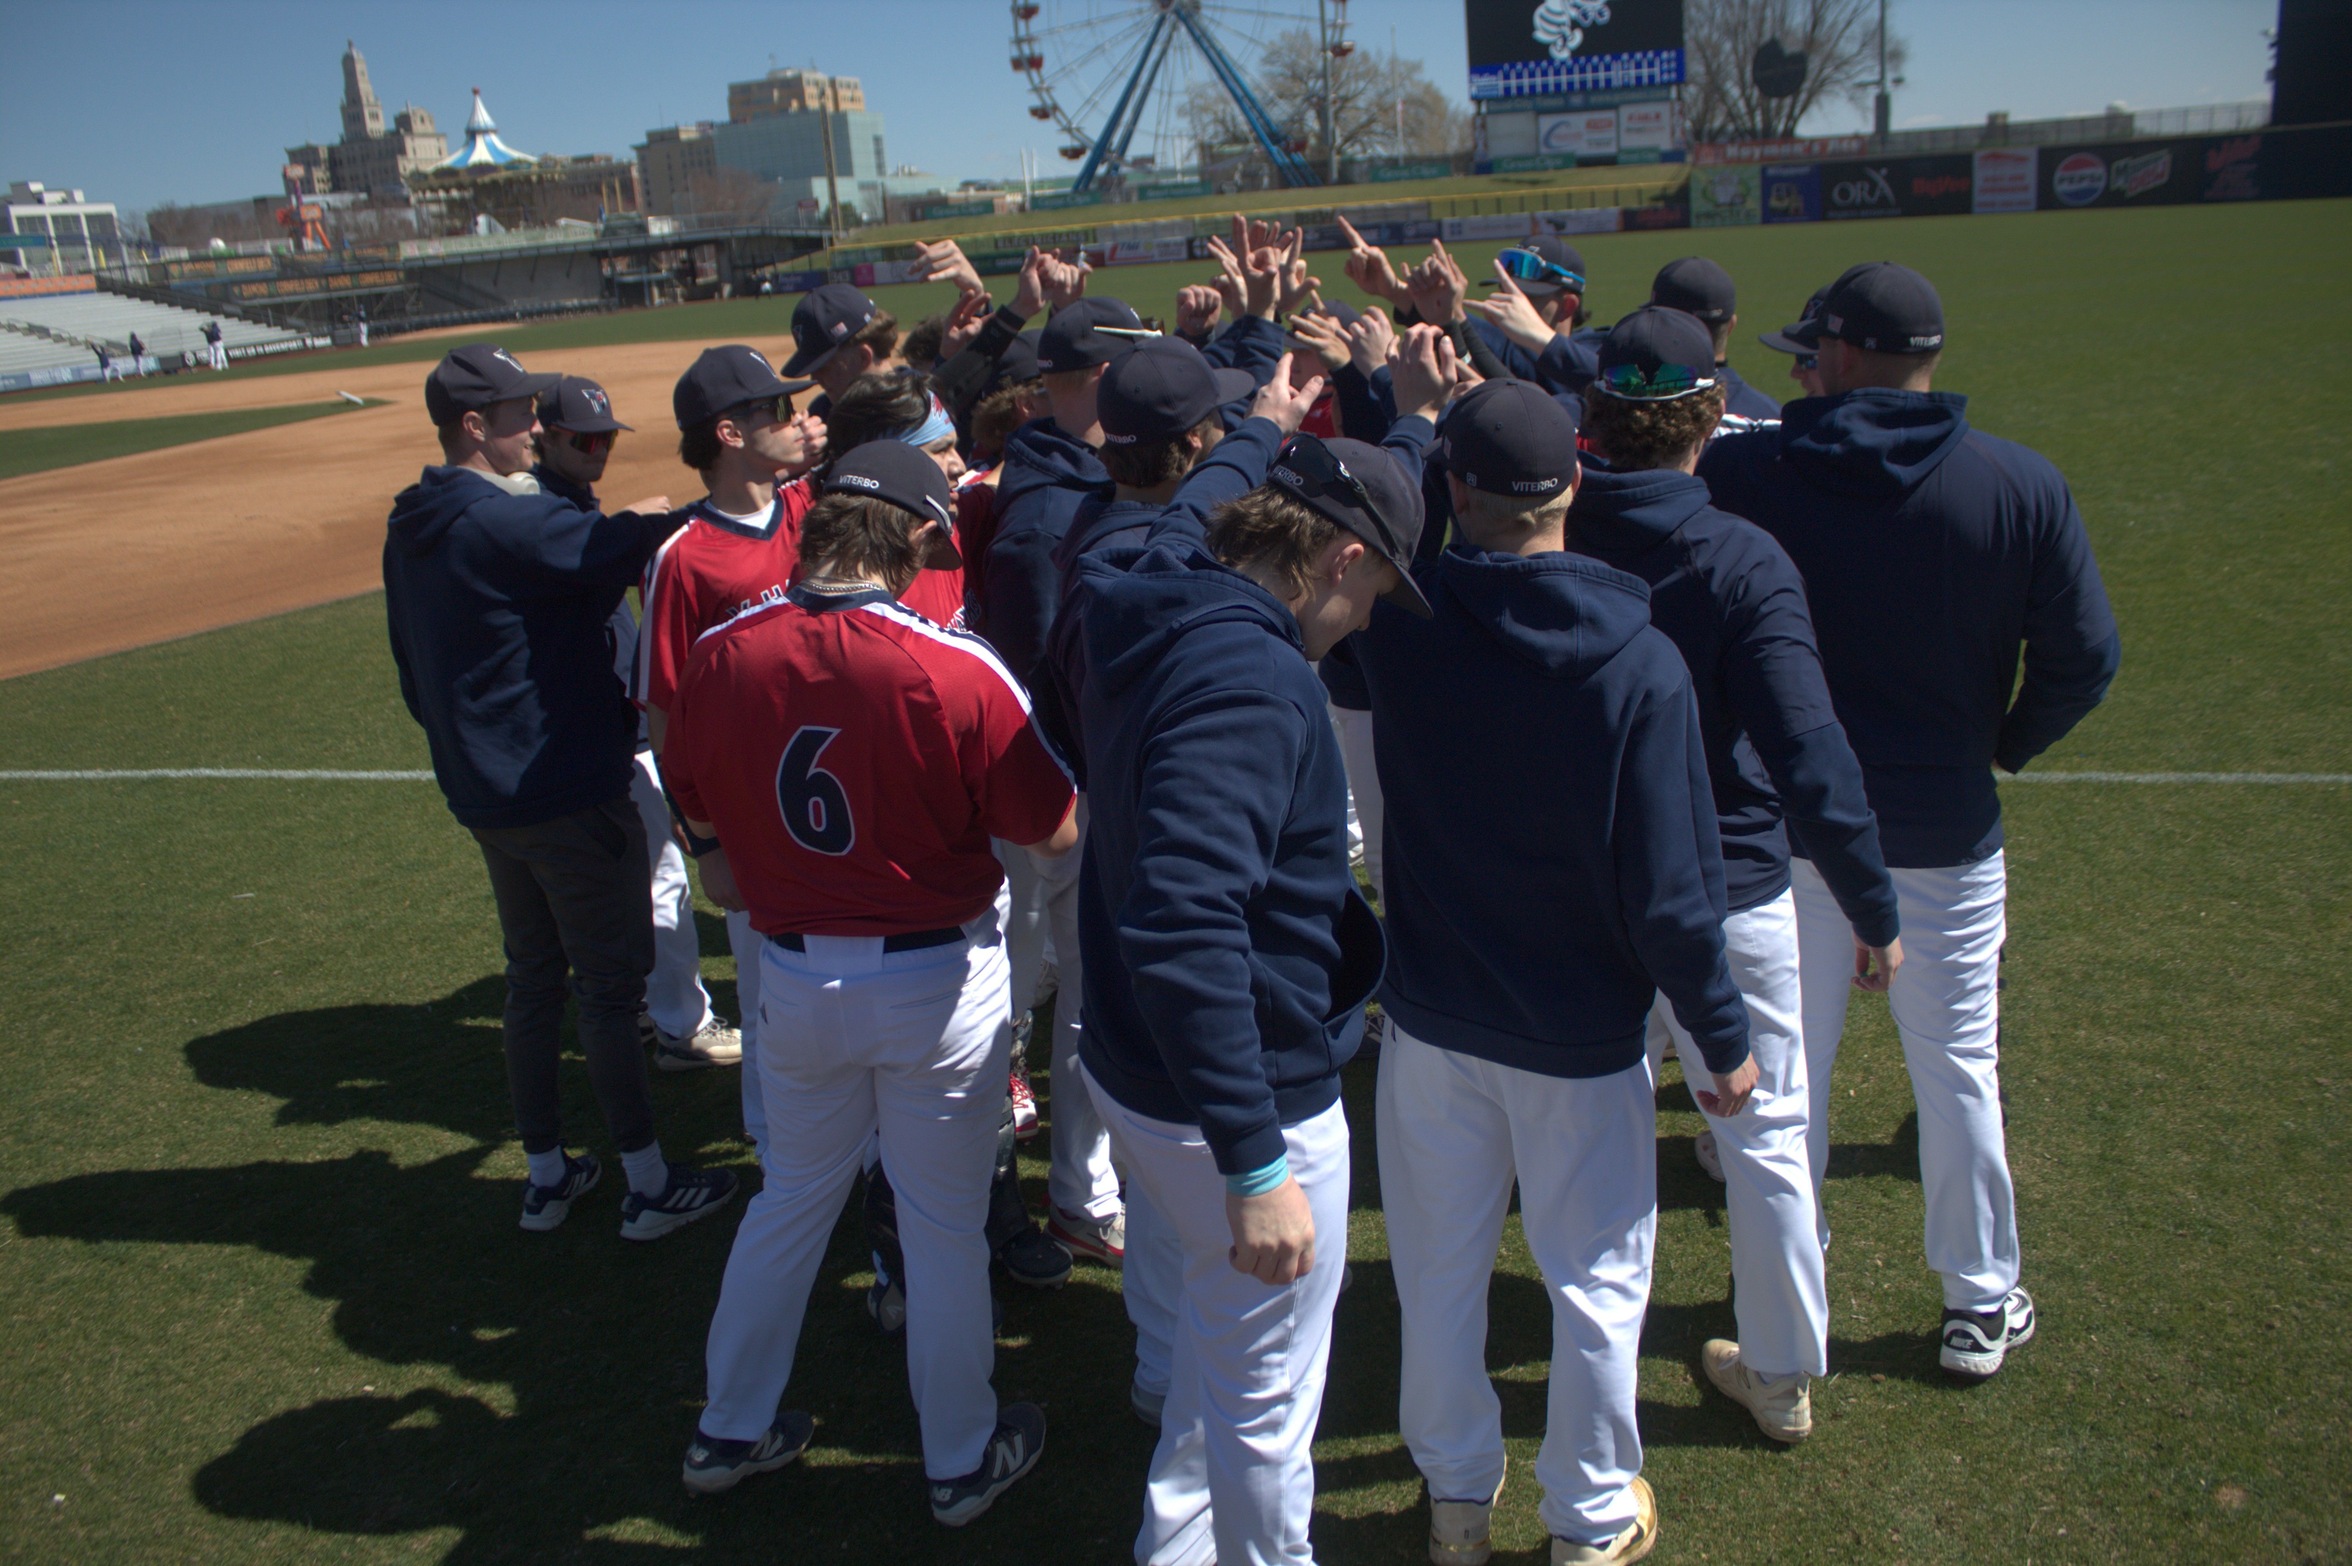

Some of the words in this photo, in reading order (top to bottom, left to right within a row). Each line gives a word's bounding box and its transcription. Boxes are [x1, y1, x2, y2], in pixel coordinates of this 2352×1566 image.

[2057, 173, 2102, 184] PEPSI
[839, 474, 880, 489] VITERBO
[1512, 477, 1558, 492] VITERBO
[775, 725, 856, 857] 6
[1950, 1334, 1974, 1350] NIKE
[932, 1486, 953, 1502] NB
